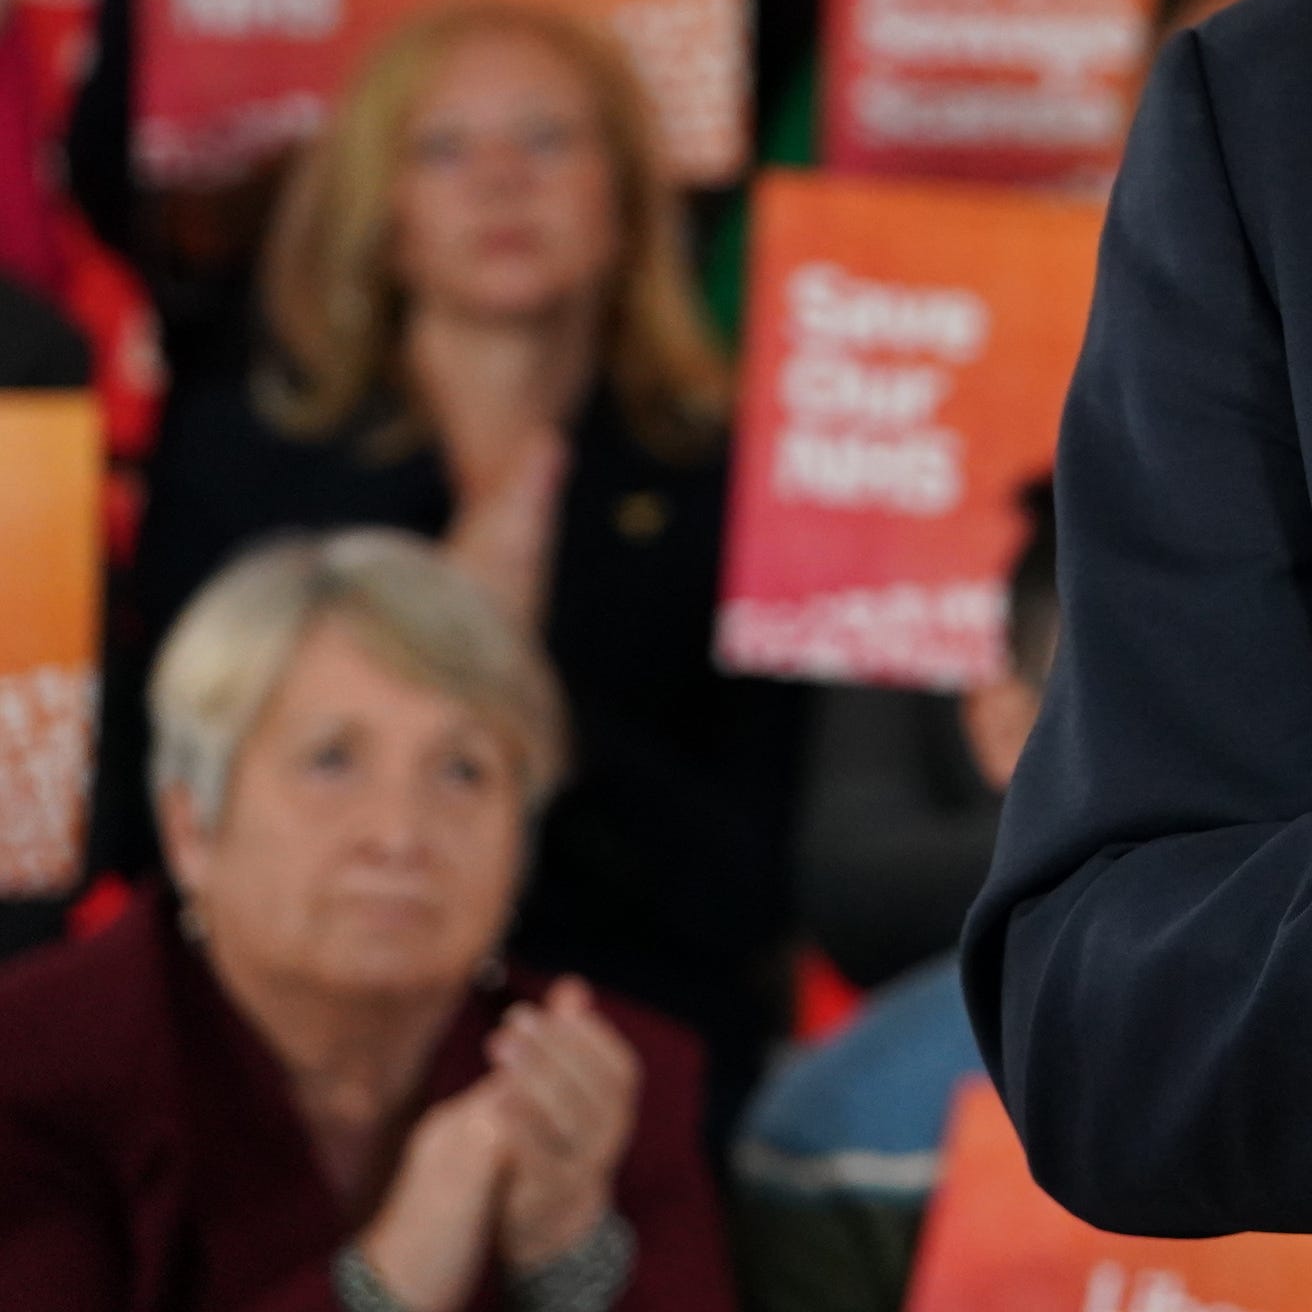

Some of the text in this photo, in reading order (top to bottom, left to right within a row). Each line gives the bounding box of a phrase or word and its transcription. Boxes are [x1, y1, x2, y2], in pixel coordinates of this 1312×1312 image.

[789, 264, 985, 359] Save
[784, 353, 948, 423] Our
[776, 429, 960, 513] NHS
